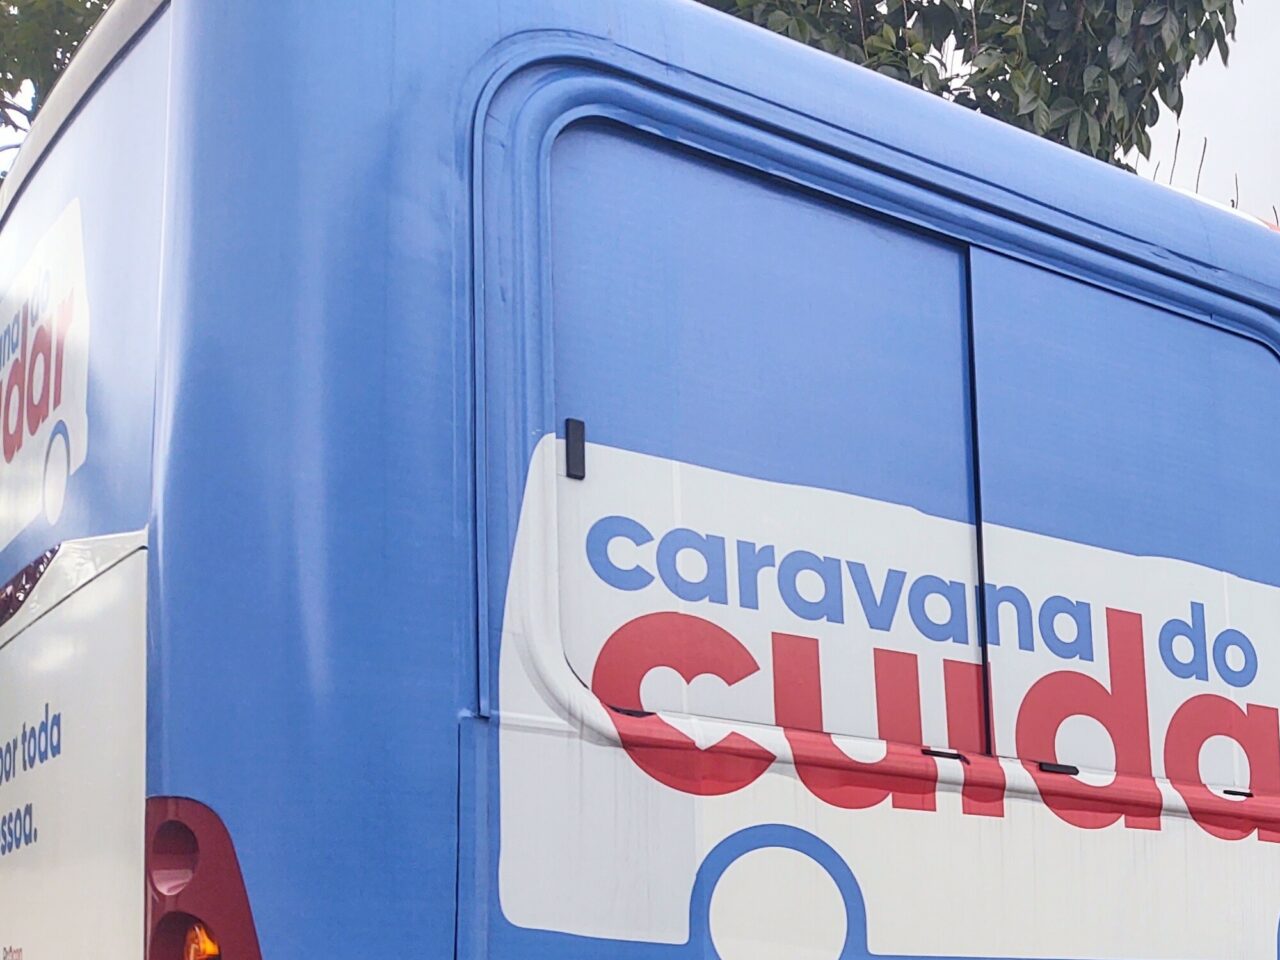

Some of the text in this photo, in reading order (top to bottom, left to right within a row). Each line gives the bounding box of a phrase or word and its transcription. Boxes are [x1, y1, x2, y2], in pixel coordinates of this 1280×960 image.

[0, 288, 73, 464] dar
[585, 515, 1258, 688] caravana do
[22, 703, 61, 772] toda
